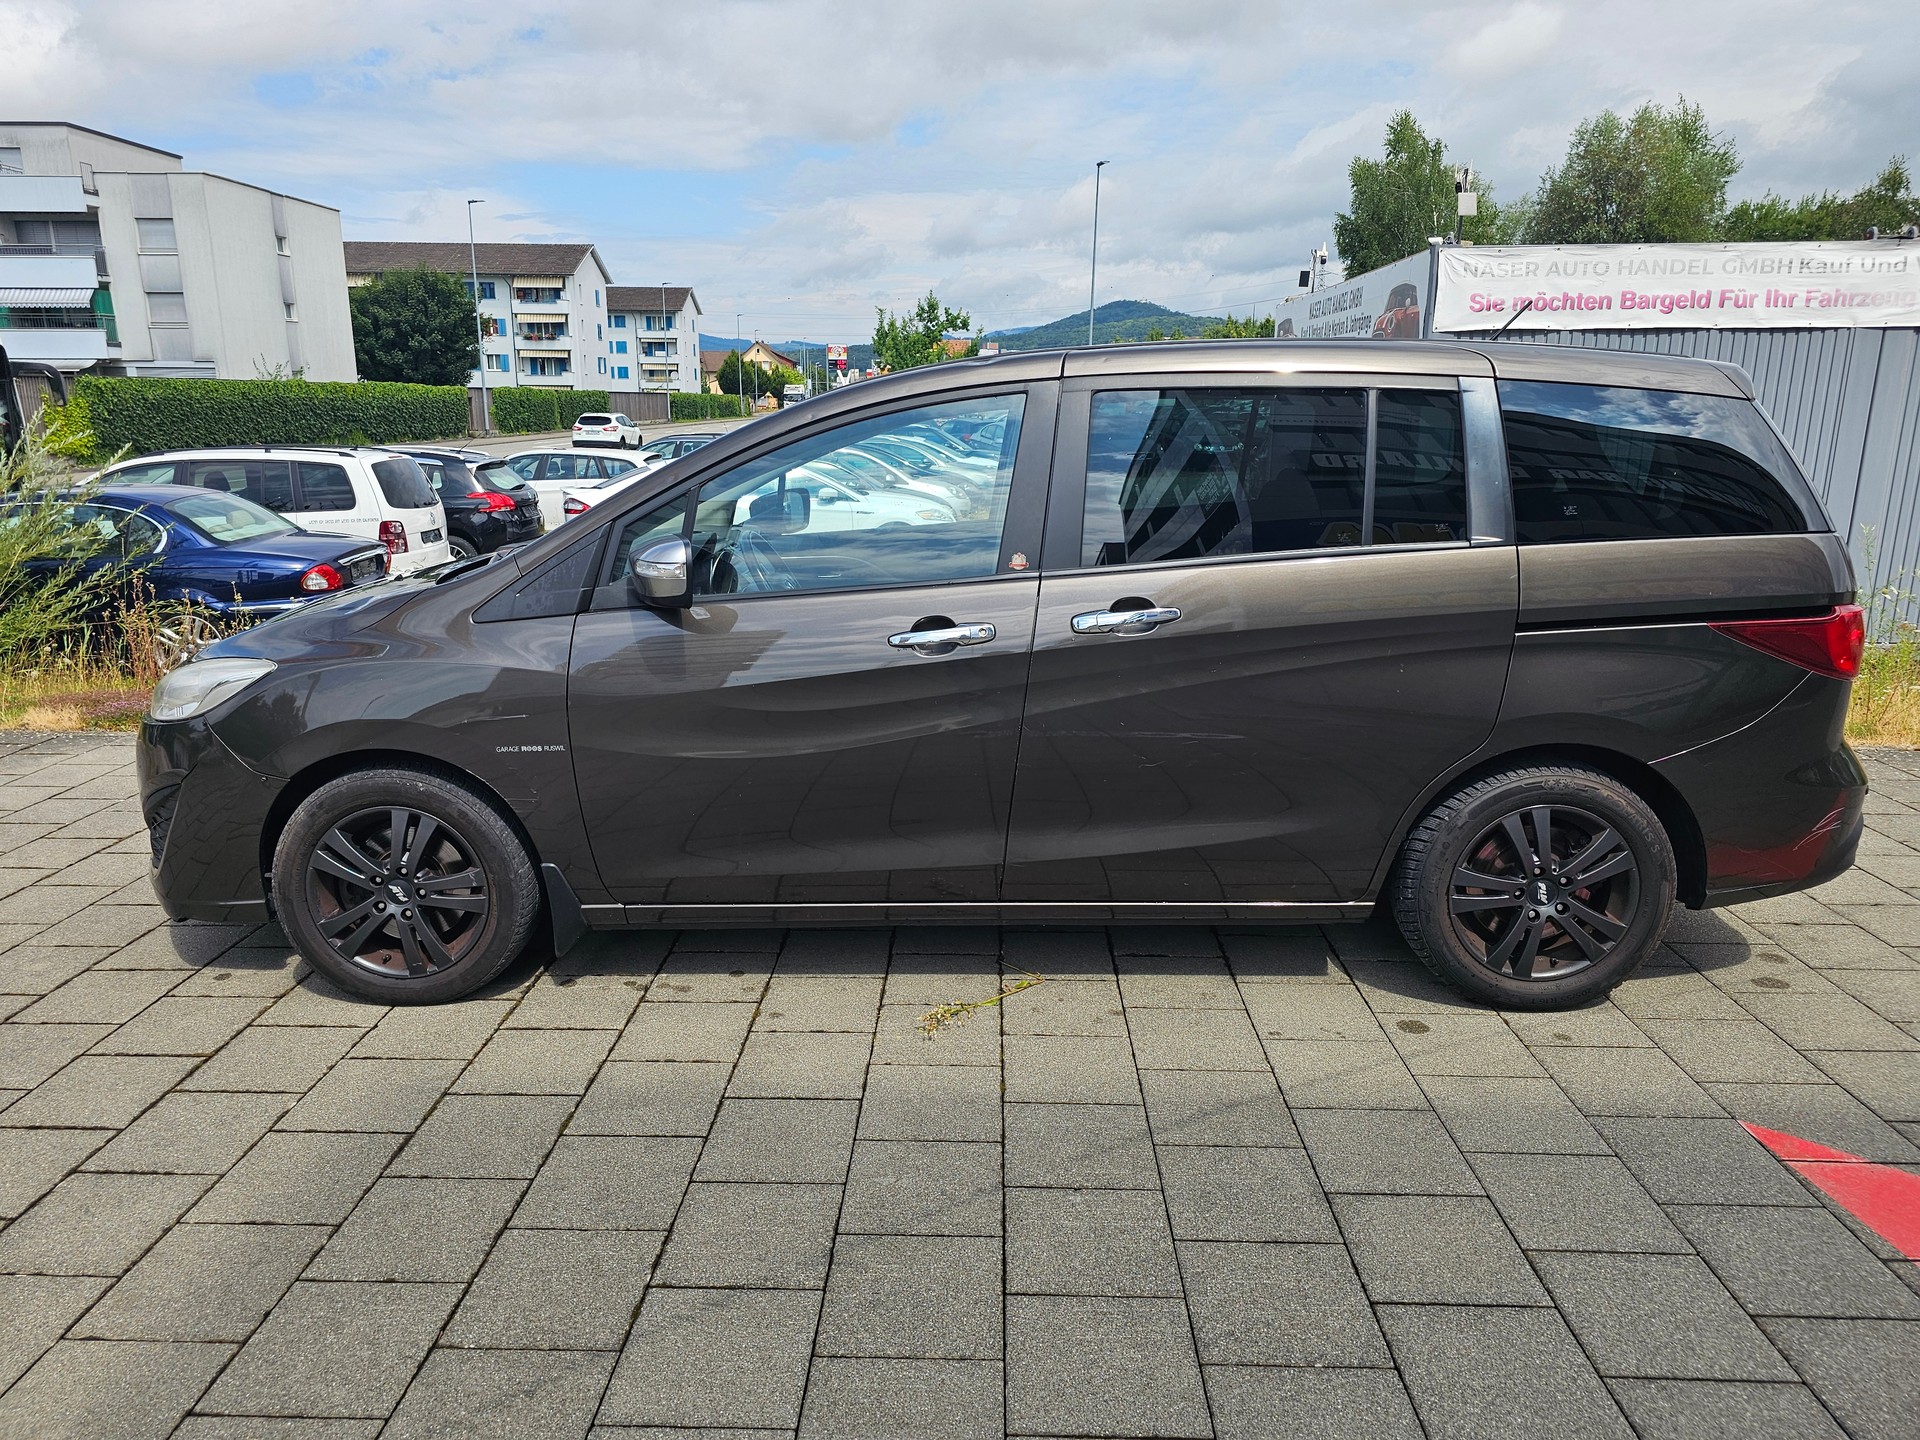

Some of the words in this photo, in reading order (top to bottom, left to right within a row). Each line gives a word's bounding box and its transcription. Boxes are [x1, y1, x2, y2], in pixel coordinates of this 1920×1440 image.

[1463, 260, 1540, 279] NASER
[1545, 259, 1610, 277] AUTO
[1618, 258, 1714, 276] HANDEL
[1722, 257, 1793, 275] GMBH
[1799, 256, 1854, 274] Kauf
[1861, 256, 1908, 273] Und
[1469, 292, 1506, 313] Sie
[1512, 290, 1612, 312] möchten
[1619, 289, 1713, 314] Bargeld
[1718, 287, 1760, 309] Für
[1765, 287, 1799, 309] Ihr
